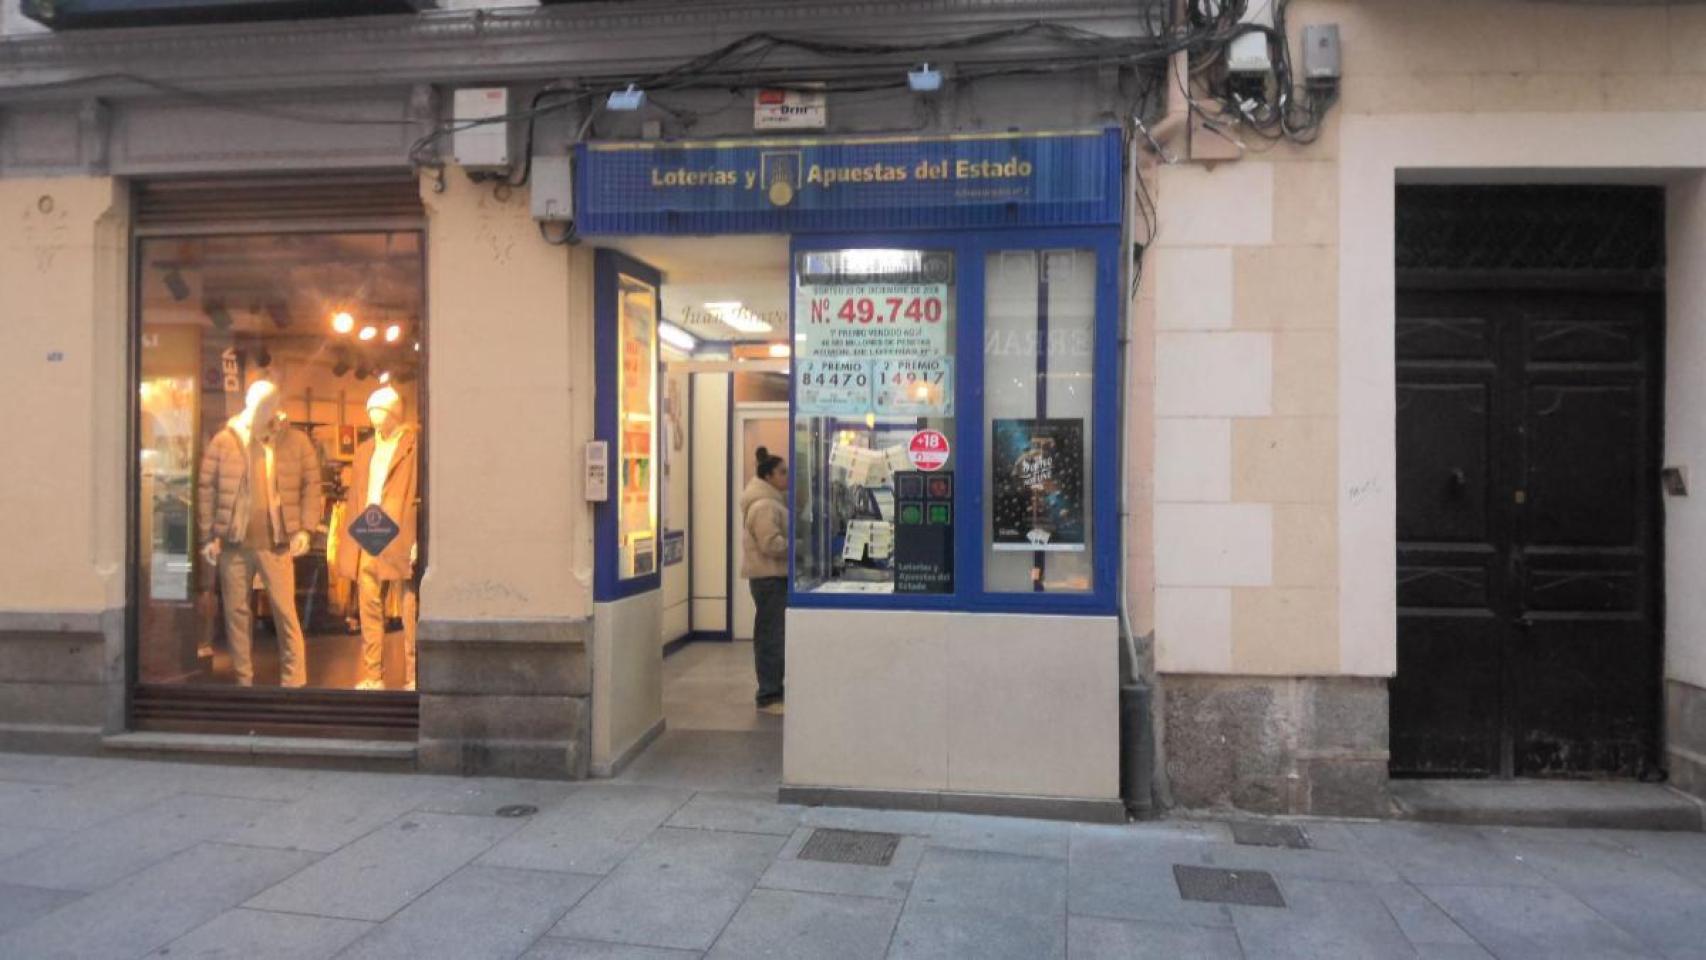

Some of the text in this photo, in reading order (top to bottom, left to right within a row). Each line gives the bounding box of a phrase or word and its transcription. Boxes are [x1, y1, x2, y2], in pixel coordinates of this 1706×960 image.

[651, 156, 1033, 190] Loterías y Apuestas del Estado
[836, 296, 943, 324] 49.740
[822, 361, 863, 371] PREMIO
[898, 360, 940, 371] PREMIO
[802, 373, 867, 387] 84470
[880, 371, 945, 386] 14917
[916, 434, 940, 448] +18
